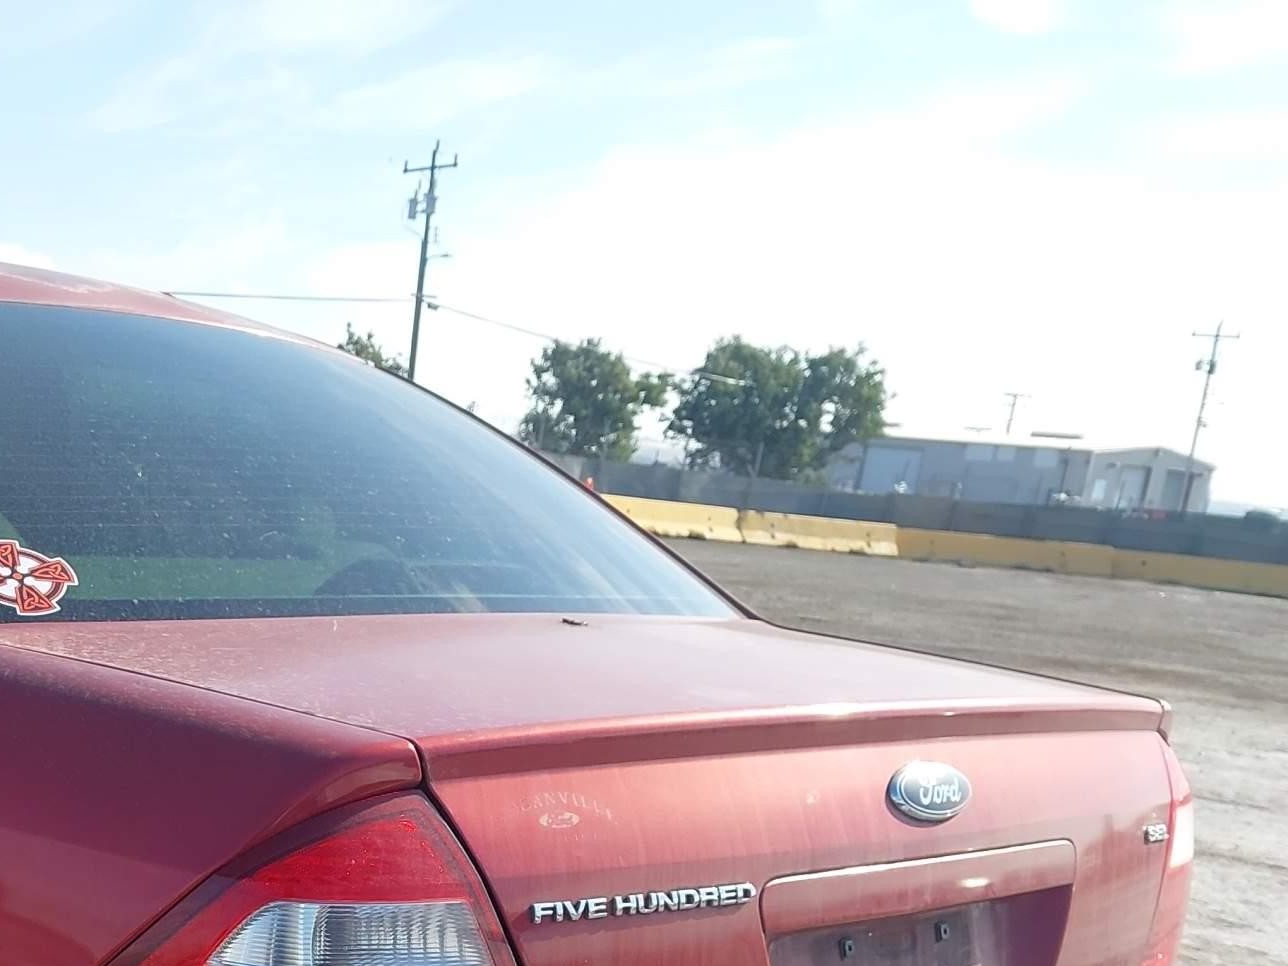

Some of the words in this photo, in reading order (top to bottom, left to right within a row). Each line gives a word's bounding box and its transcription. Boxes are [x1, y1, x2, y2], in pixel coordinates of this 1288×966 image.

[917, 774, 962, 806] Ford
[533, 897, 608, 924] FIVE
[614, 882, 757, 916] HUNDRED
